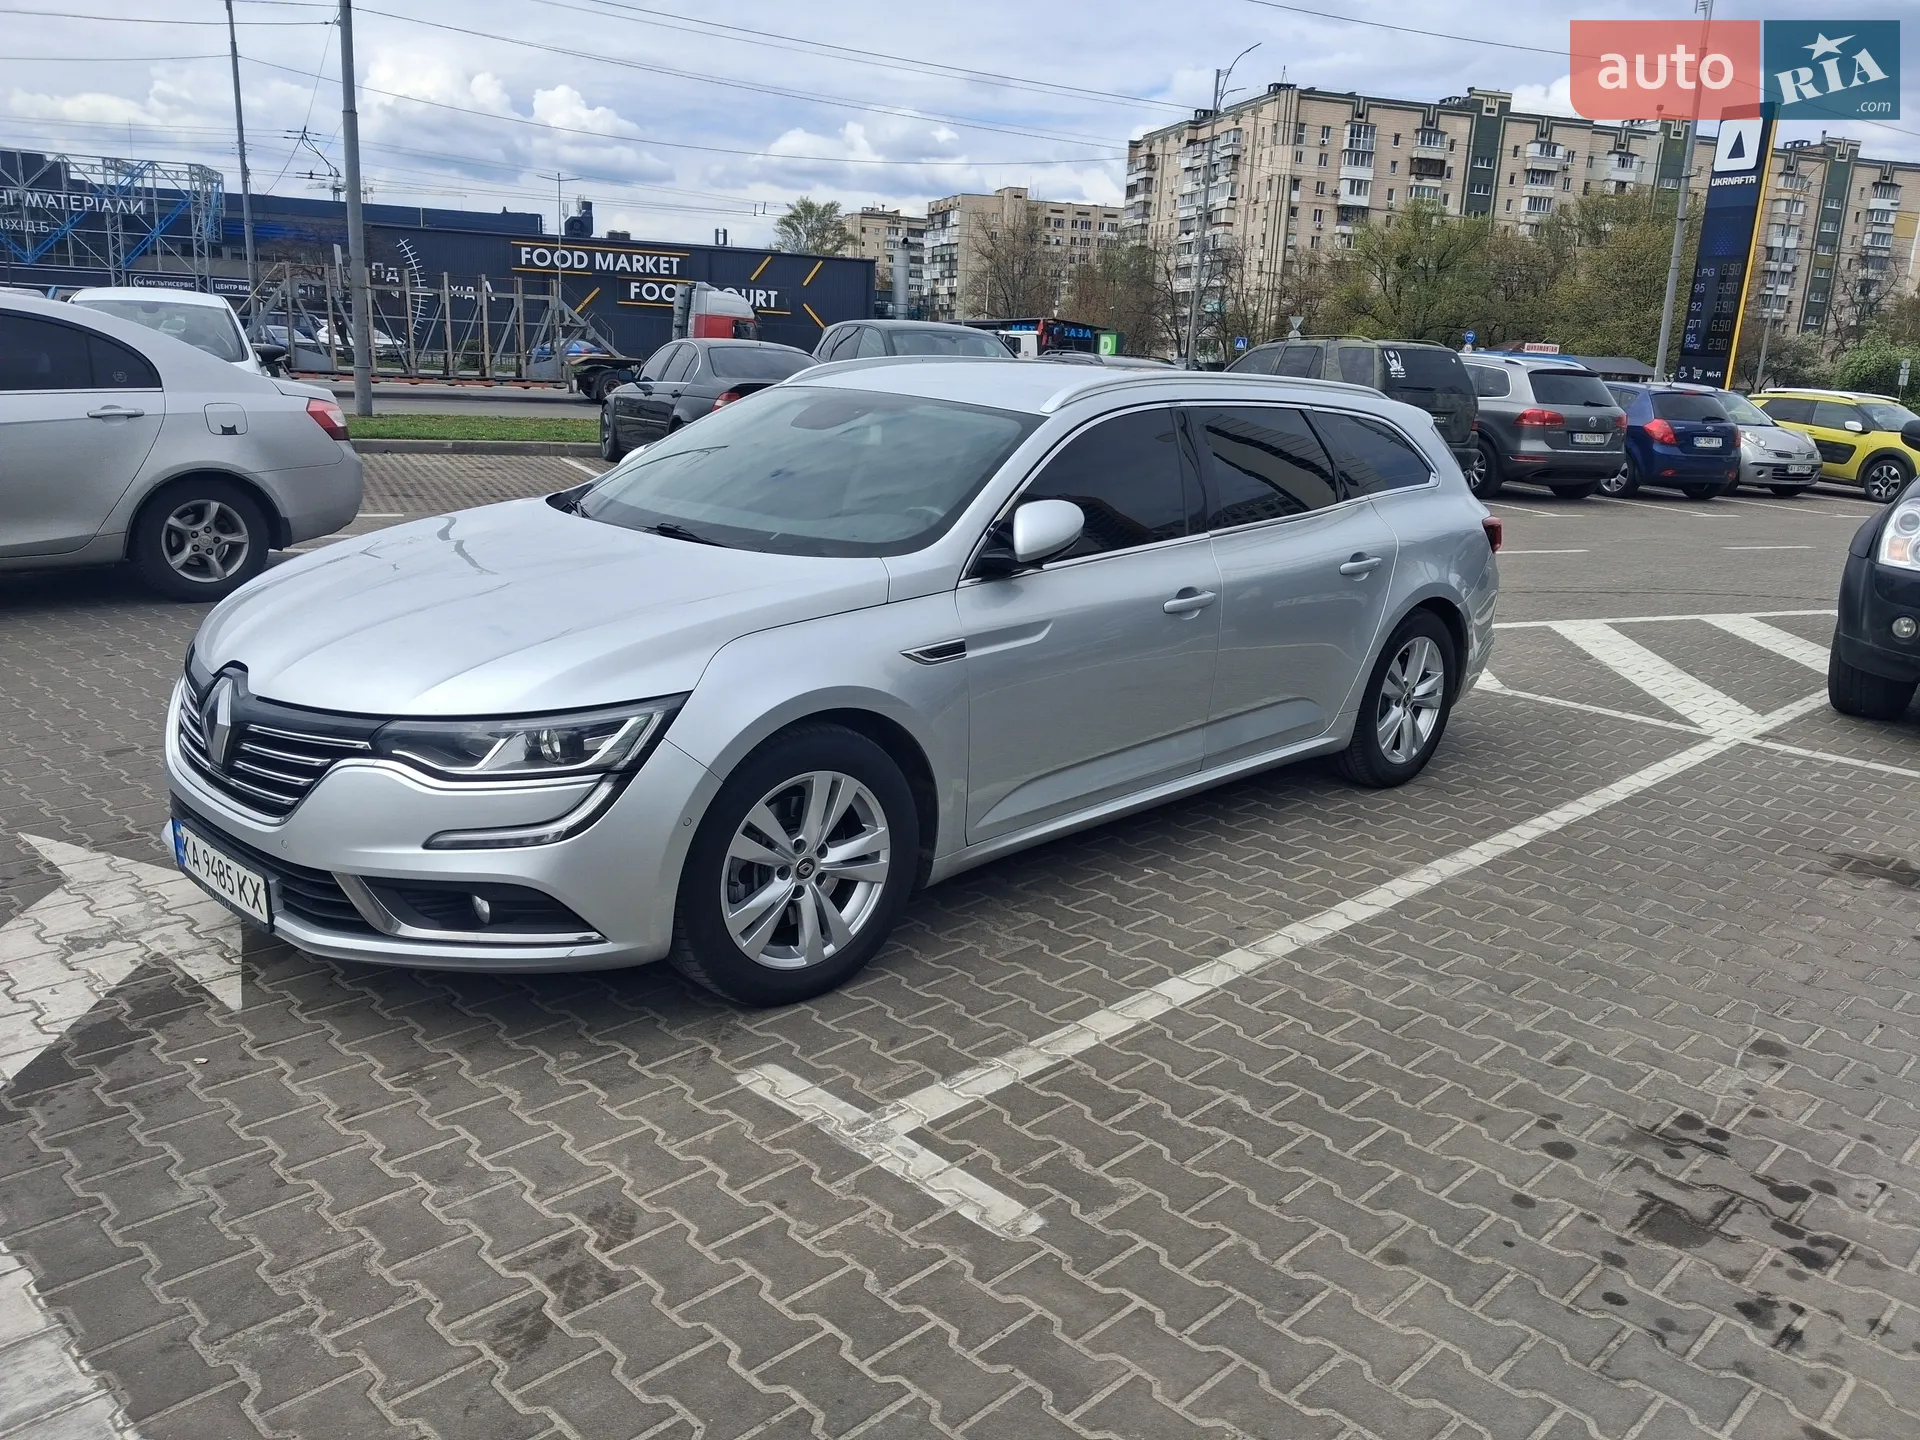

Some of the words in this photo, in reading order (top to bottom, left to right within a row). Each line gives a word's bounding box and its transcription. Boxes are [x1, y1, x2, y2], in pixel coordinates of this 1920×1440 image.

[1711, 175, 1757, 186] UKRNAFTA
[25, 191, 144, 215] МАТЕРІАЛИ
[521, 246, 589, 269] FOOD
[595, 252, 680, 275] MARKET
[1696, 268, 1715, 278] LPG
[215, 283, 237, 292] ЦЕНТР
[630, 282, 676, 302] FOO
[1694, 283, 1706, 293] 95
[1691, 302, 1702, 312] 92
[1685, 333, 1697, 343] 95
[1706, 370, 1722, 378] Wi-Fi
[182, 836, 202, 873] KA
[202, 849, 235, 896] 9485
[236, 871, 263, 915] KX
